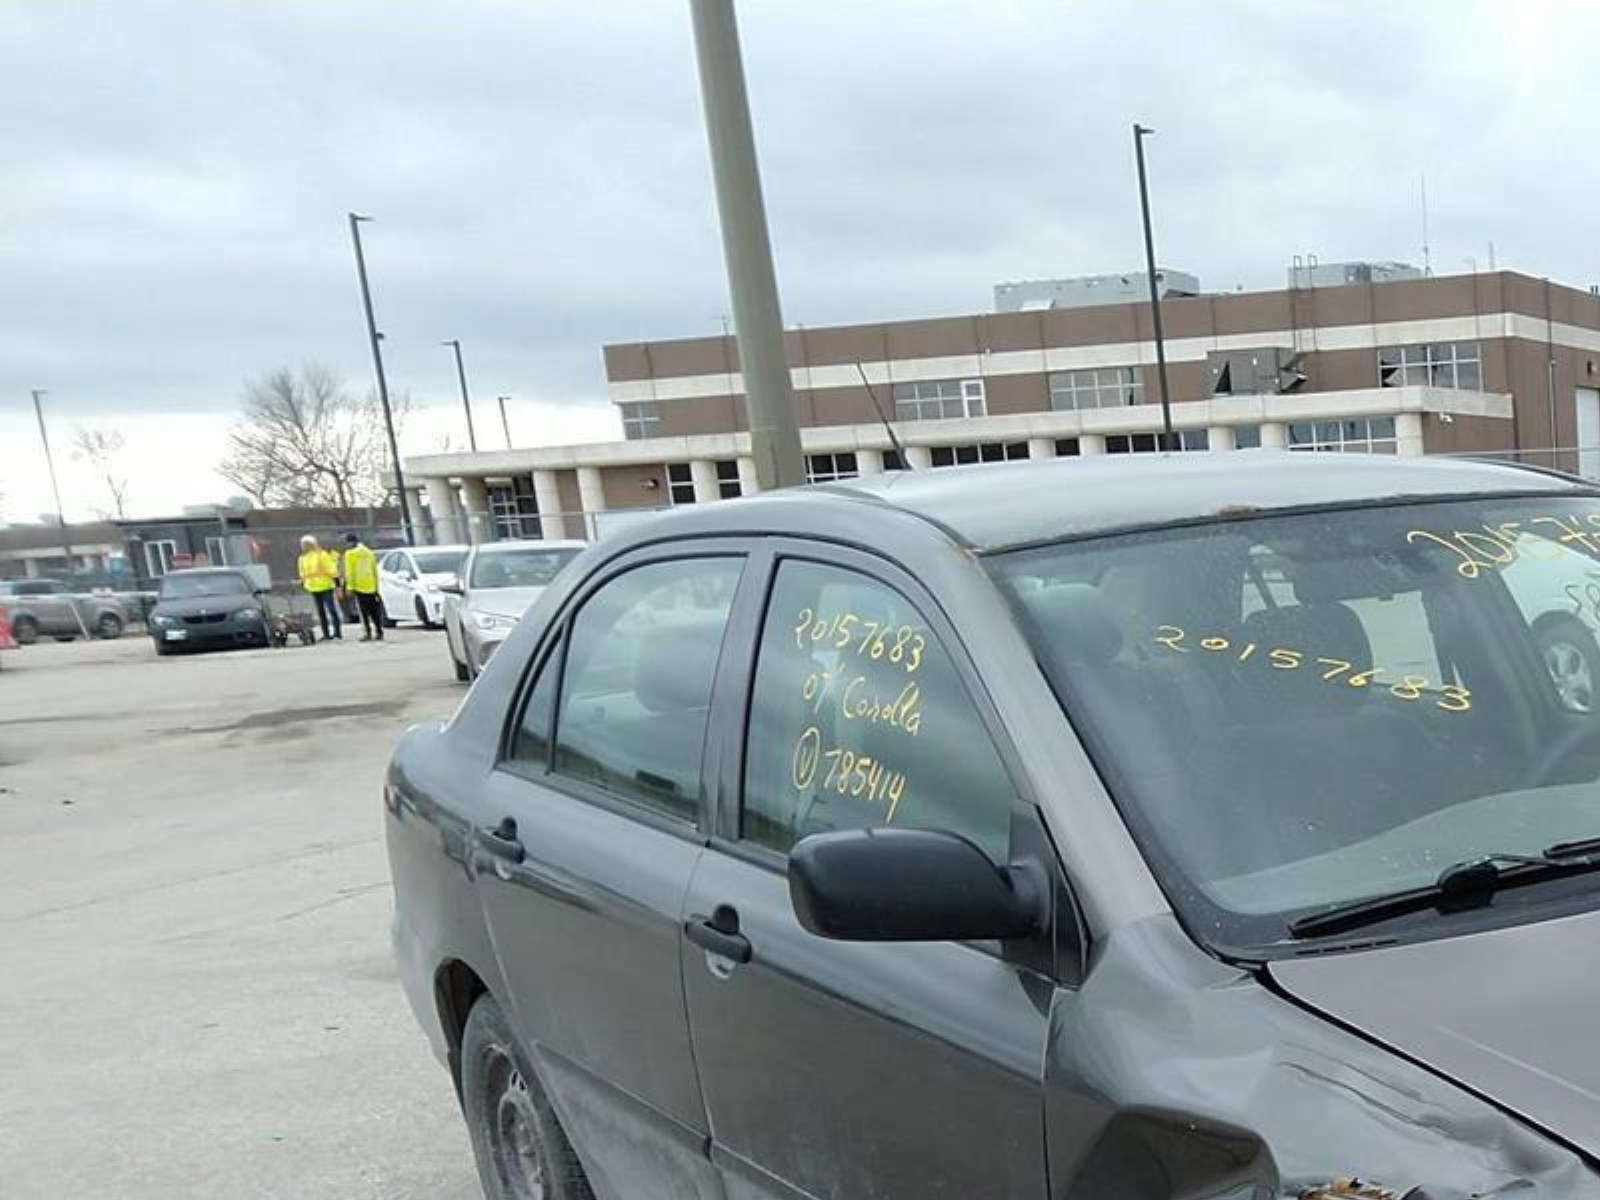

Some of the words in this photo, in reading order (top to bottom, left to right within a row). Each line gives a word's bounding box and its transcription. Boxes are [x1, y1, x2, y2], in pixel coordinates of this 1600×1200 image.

[795, 608, 925, 671] 20157683
[1155, 625, 1471, 710] 20157683
[823, 750, 906, 823] 785414
